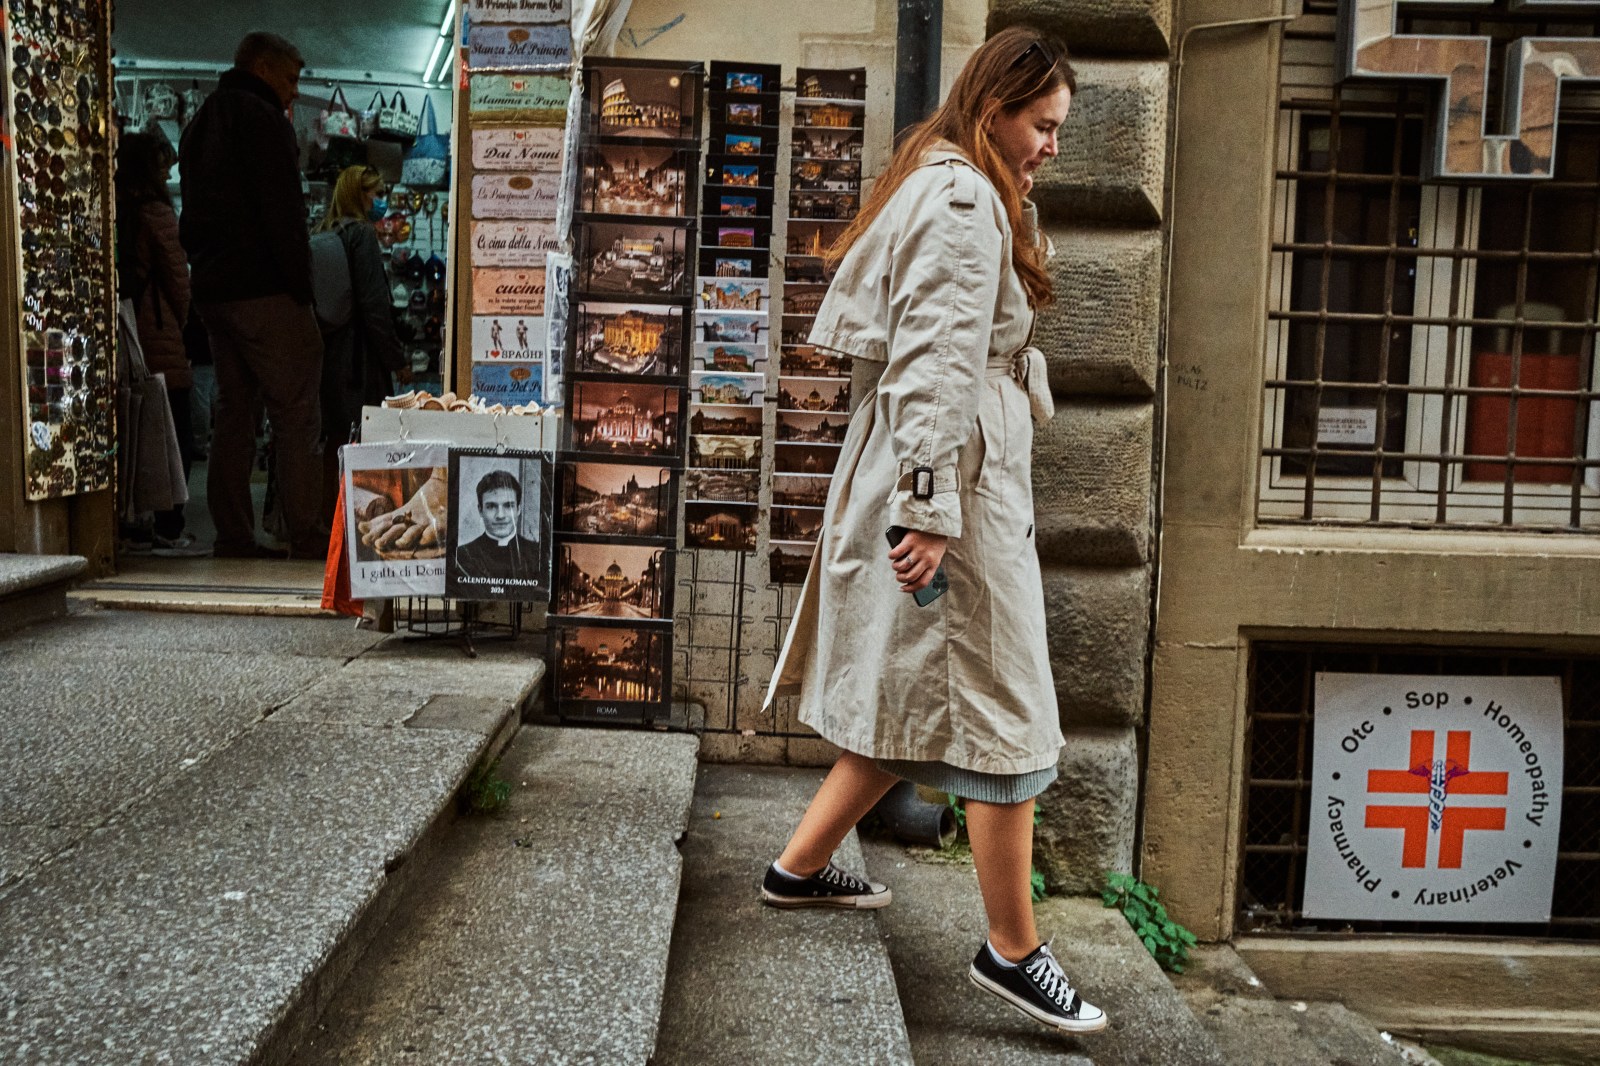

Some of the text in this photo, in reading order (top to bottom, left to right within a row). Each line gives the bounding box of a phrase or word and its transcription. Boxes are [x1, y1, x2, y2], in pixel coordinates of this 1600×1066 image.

[471, 43, 569, 59] Stanza Del Principe
[473, 94, 522, 106] Mamma
[483, 148, 562, 160] Dai Nonni
[508, 234, 531, 251] della
[495, 281, 545, 295] cucina
[474, 381, 508, 394] Stanza
[509, 381, 529, 394] Del
[369, 567, 395, 583] gatti
[400, 565, 411, 577] di
[457, 576, 539, 587] CALENDARIO ROMANO
[490, 586, 505, 594] 2024
[596, 706, 618, 715] ROMA
[1328, 690, 1550, 906] Pharmacy Otc Sop Homeopathy Veterinary
